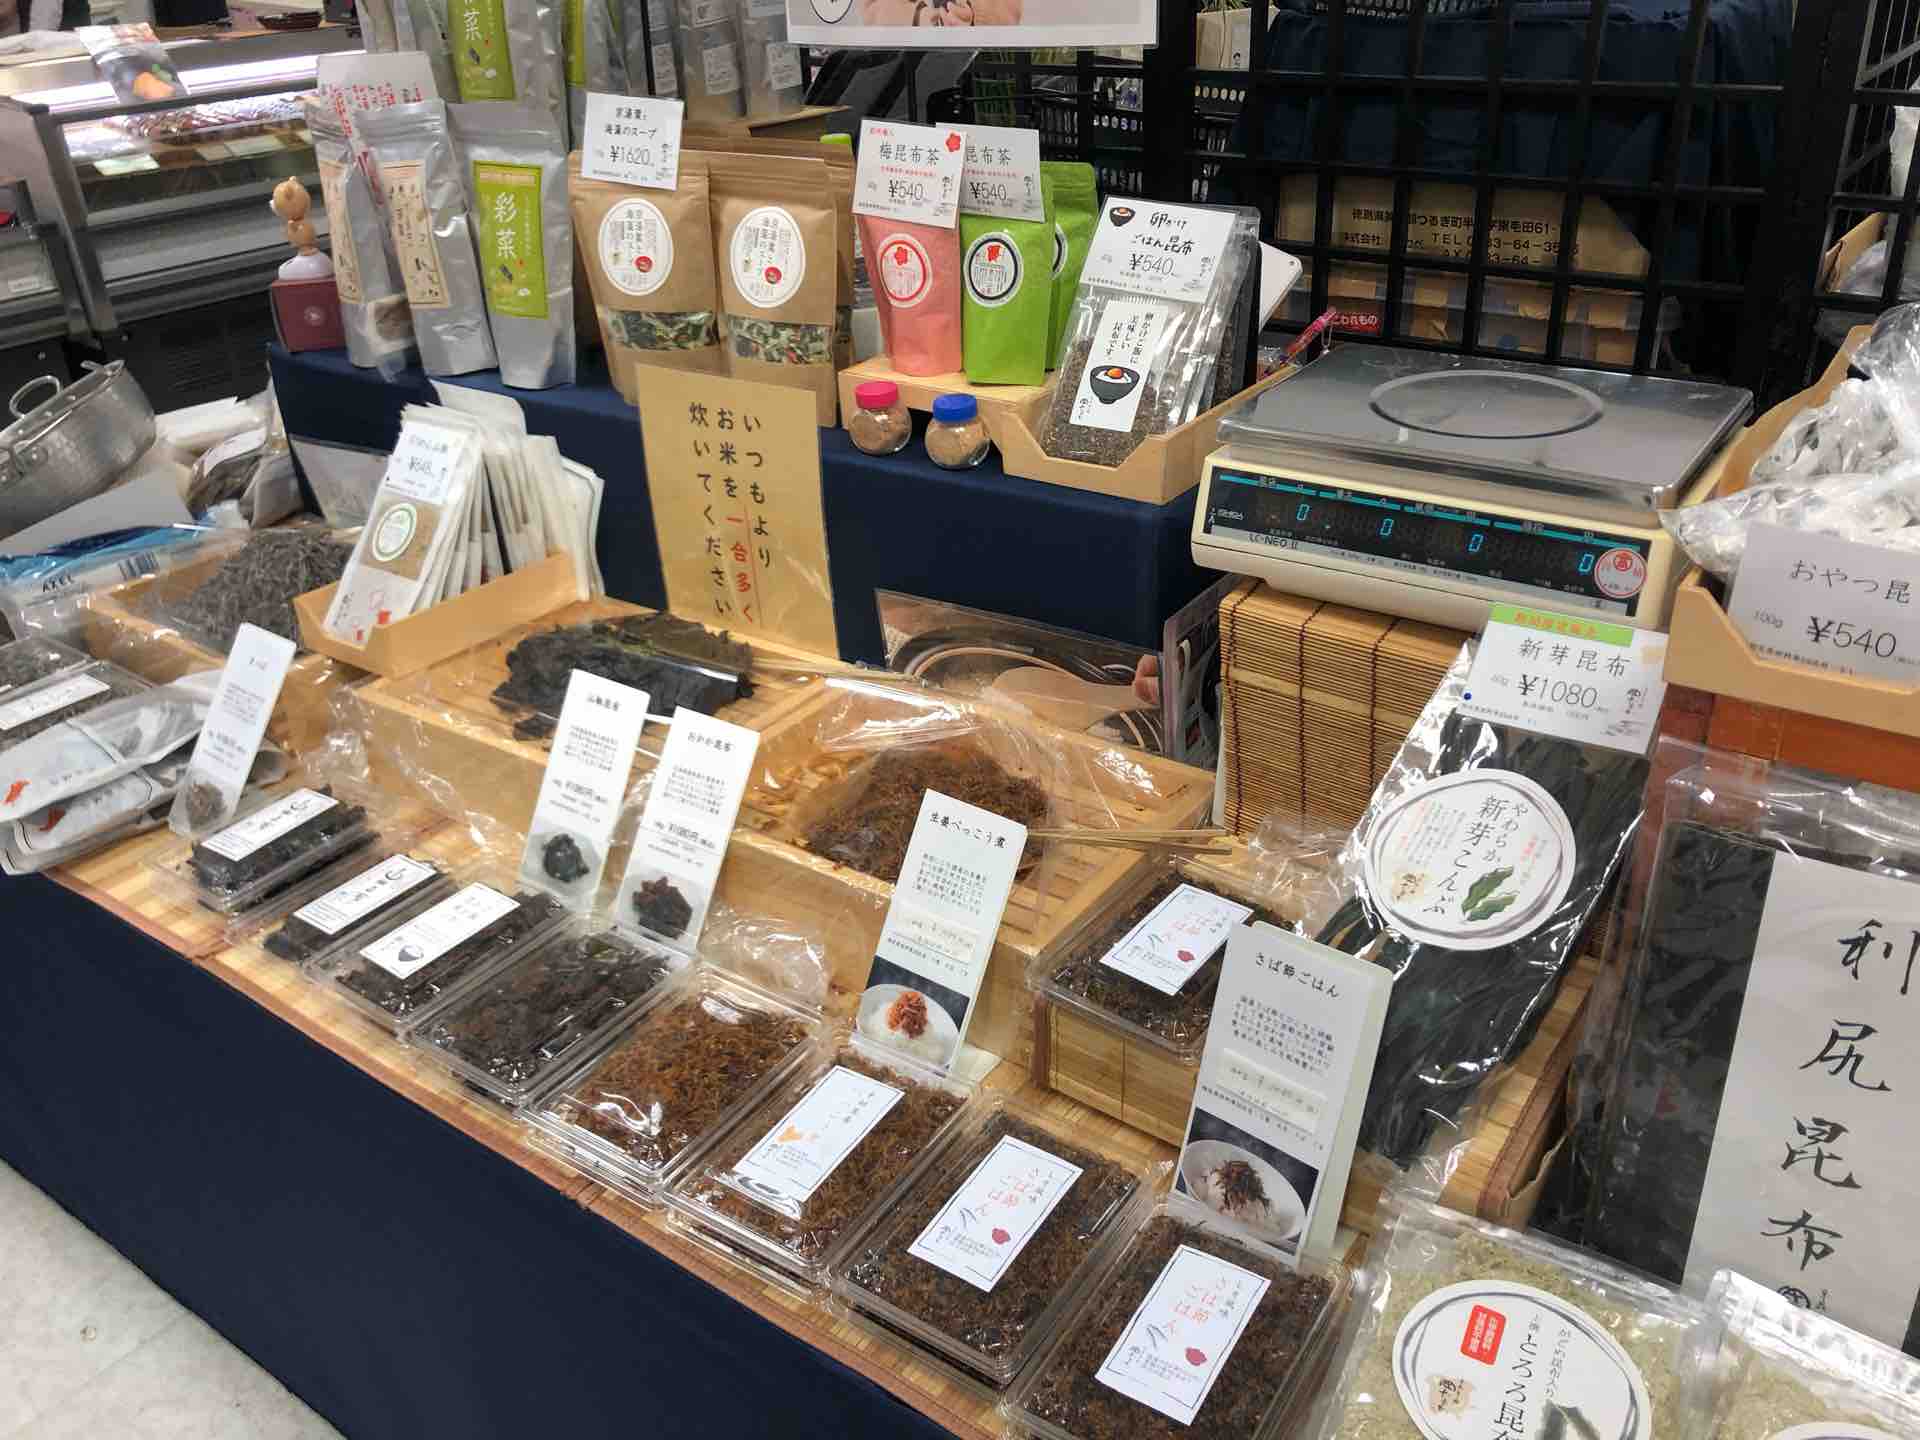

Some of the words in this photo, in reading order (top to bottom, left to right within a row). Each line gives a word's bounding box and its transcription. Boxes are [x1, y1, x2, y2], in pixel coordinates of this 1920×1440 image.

[609, 144, 651, 166] ¥1620
[879, 140, 940, 166] 梅昆布茶
[889, 179, 924, 201] ¥540
[970, 182, 1007, 202] ¥540
[1129, 252, 1175, 276] ¥540
[743, 414, 771, 568] いつもより
[689, 402, 732, 617] 炊いてください
[717, 407, 753, 625] お米を一合多く
[1379, 518, 1394, 537] 0
[1468, 533, 1484, 553] 0
[1577, 553, 1595, 573] 0
[1807, 616, 1897, 658] ¥540
[1519, 637, 1631, 677] 新芽昆布
[1518, 674, 1598, 709] ¥1080
[1254, 951, 1341, 999] さば節ごはん
[1760, 918, 1920, 1272] 利尻昆布
